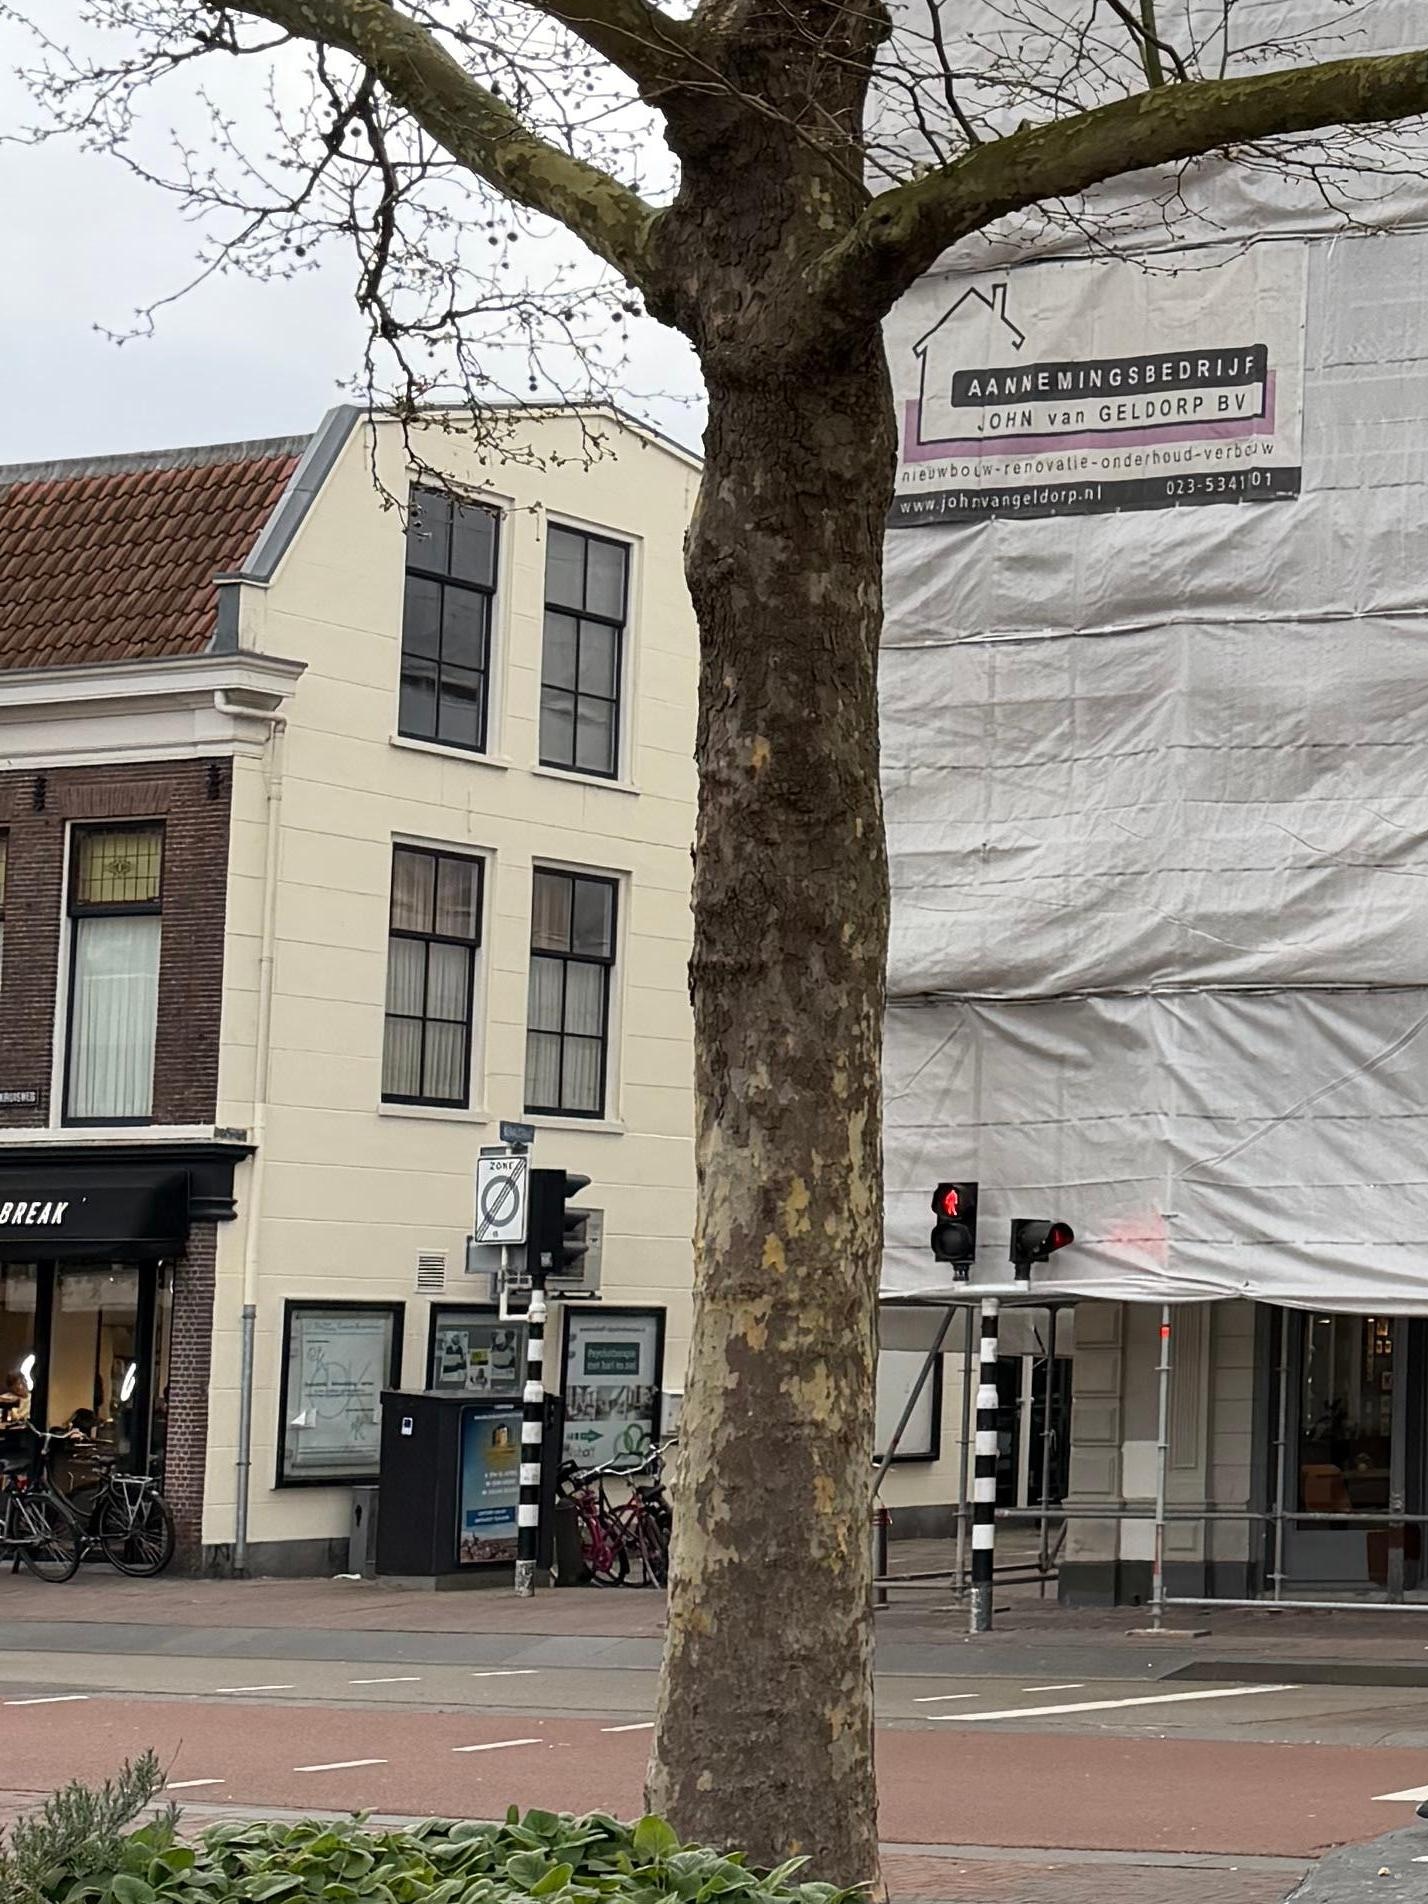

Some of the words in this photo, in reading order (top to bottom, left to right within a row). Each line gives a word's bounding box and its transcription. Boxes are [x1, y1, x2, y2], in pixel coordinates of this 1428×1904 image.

[968, 355, 1256, 398] AANNEMINGSBEDRIJF
[977, 410, 1034, 433] JOHN
[1048, 409, 1085, 426] van
[1098, 397, 1206, 423] GELDORP
[1217, 393, 1248, 412] BV
[900, 485, 1103, 515] www.johnvangeldorp.nl
[1166, 472, 1273, 496] 023-534101
[0, 1202, 68, 1225] BREAK
